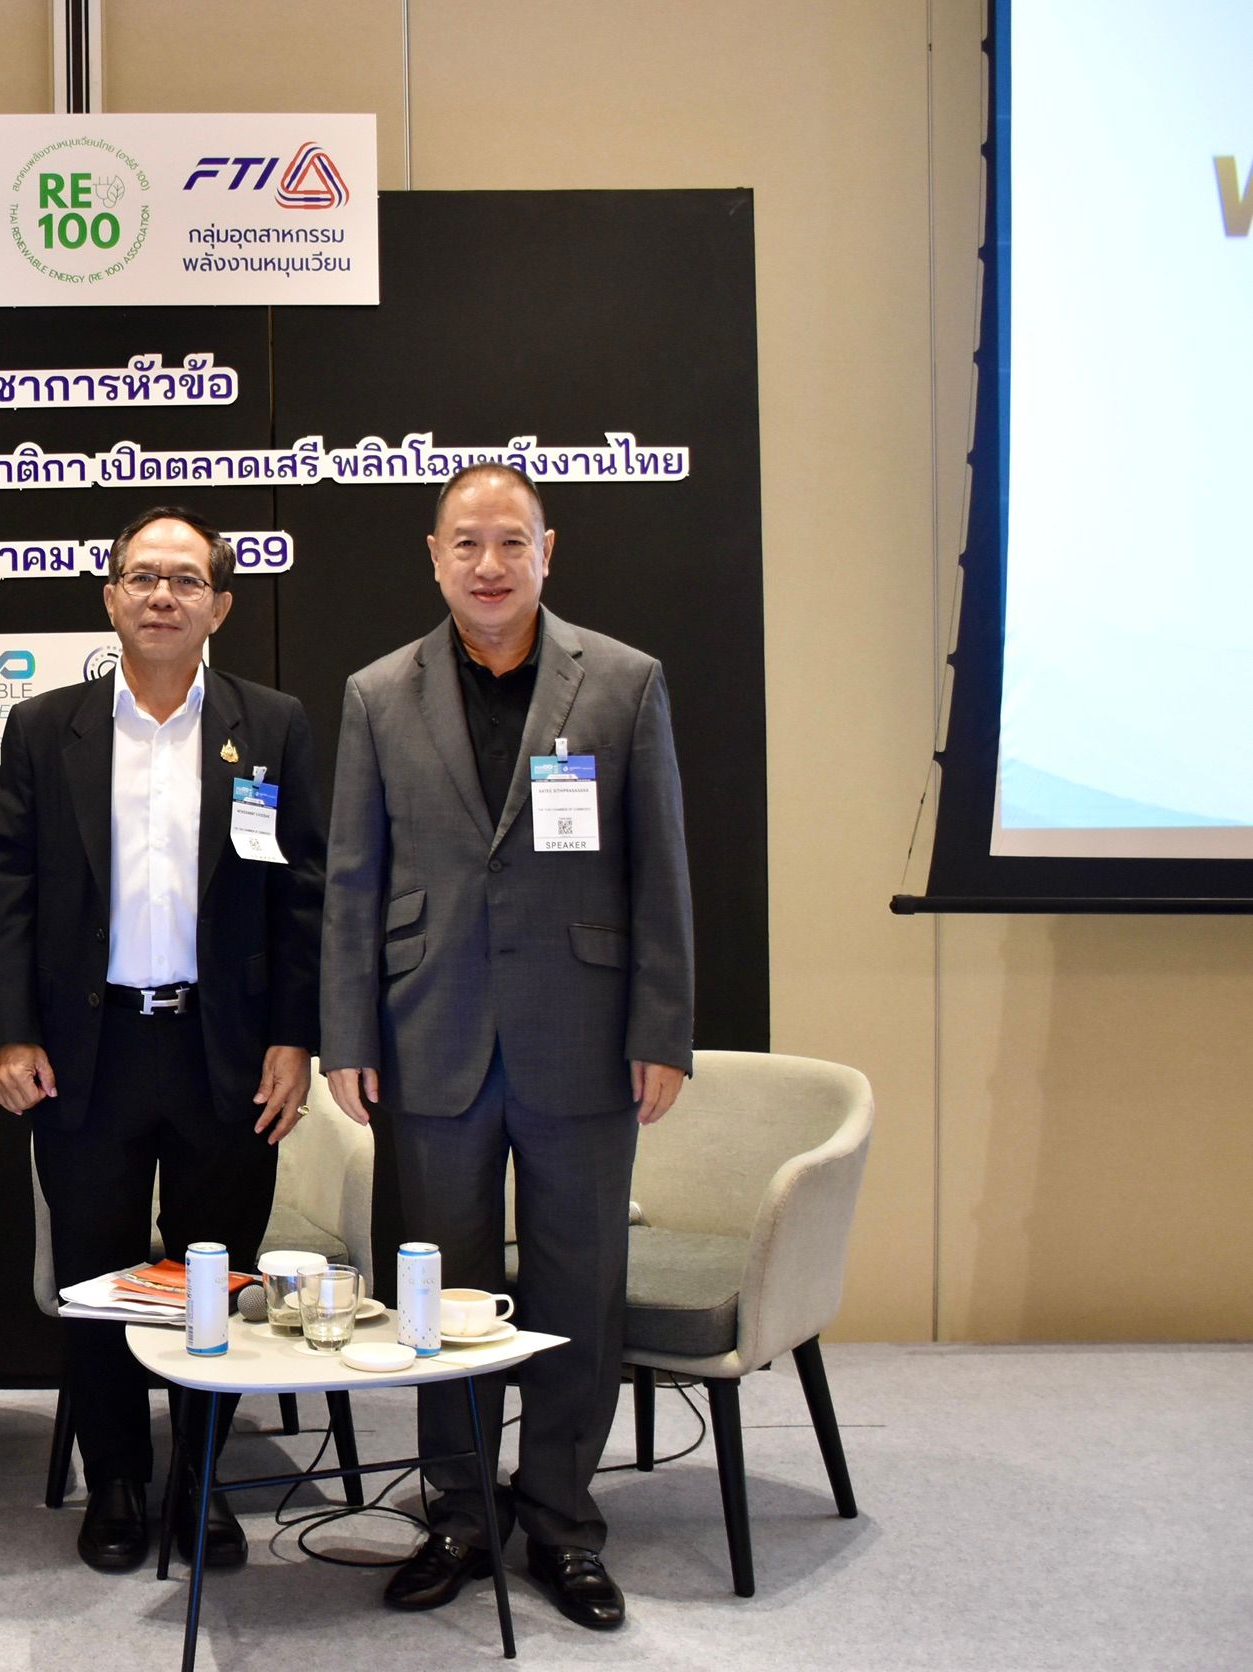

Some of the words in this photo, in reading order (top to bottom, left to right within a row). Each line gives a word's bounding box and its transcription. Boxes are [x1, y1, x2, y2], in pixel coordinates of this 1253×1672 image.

[183, 158, 280, 190] FTI
[39, 173, 92, 209] RE
[9, 203, 19, 225] THAI
[38, 212, 120, 249] 100
[123, 205, 150, 265] ASSOCIATION
[188, 223, 345, 249] กลุ่มอุตสาหกรรม
[11, 226, 48, 275] RENEWABLE
[48, 269, 85, 284] ENERGY
[105, 262, 125, 277] 100)
[182, 252, 351, 278] พลังงานหมุนเวียน
[88, 272, 104, 285] (RE
[100, 442, 319, 483] เปิดตลาดเสรี
[545, 841, 587, 850] SPEAKER
